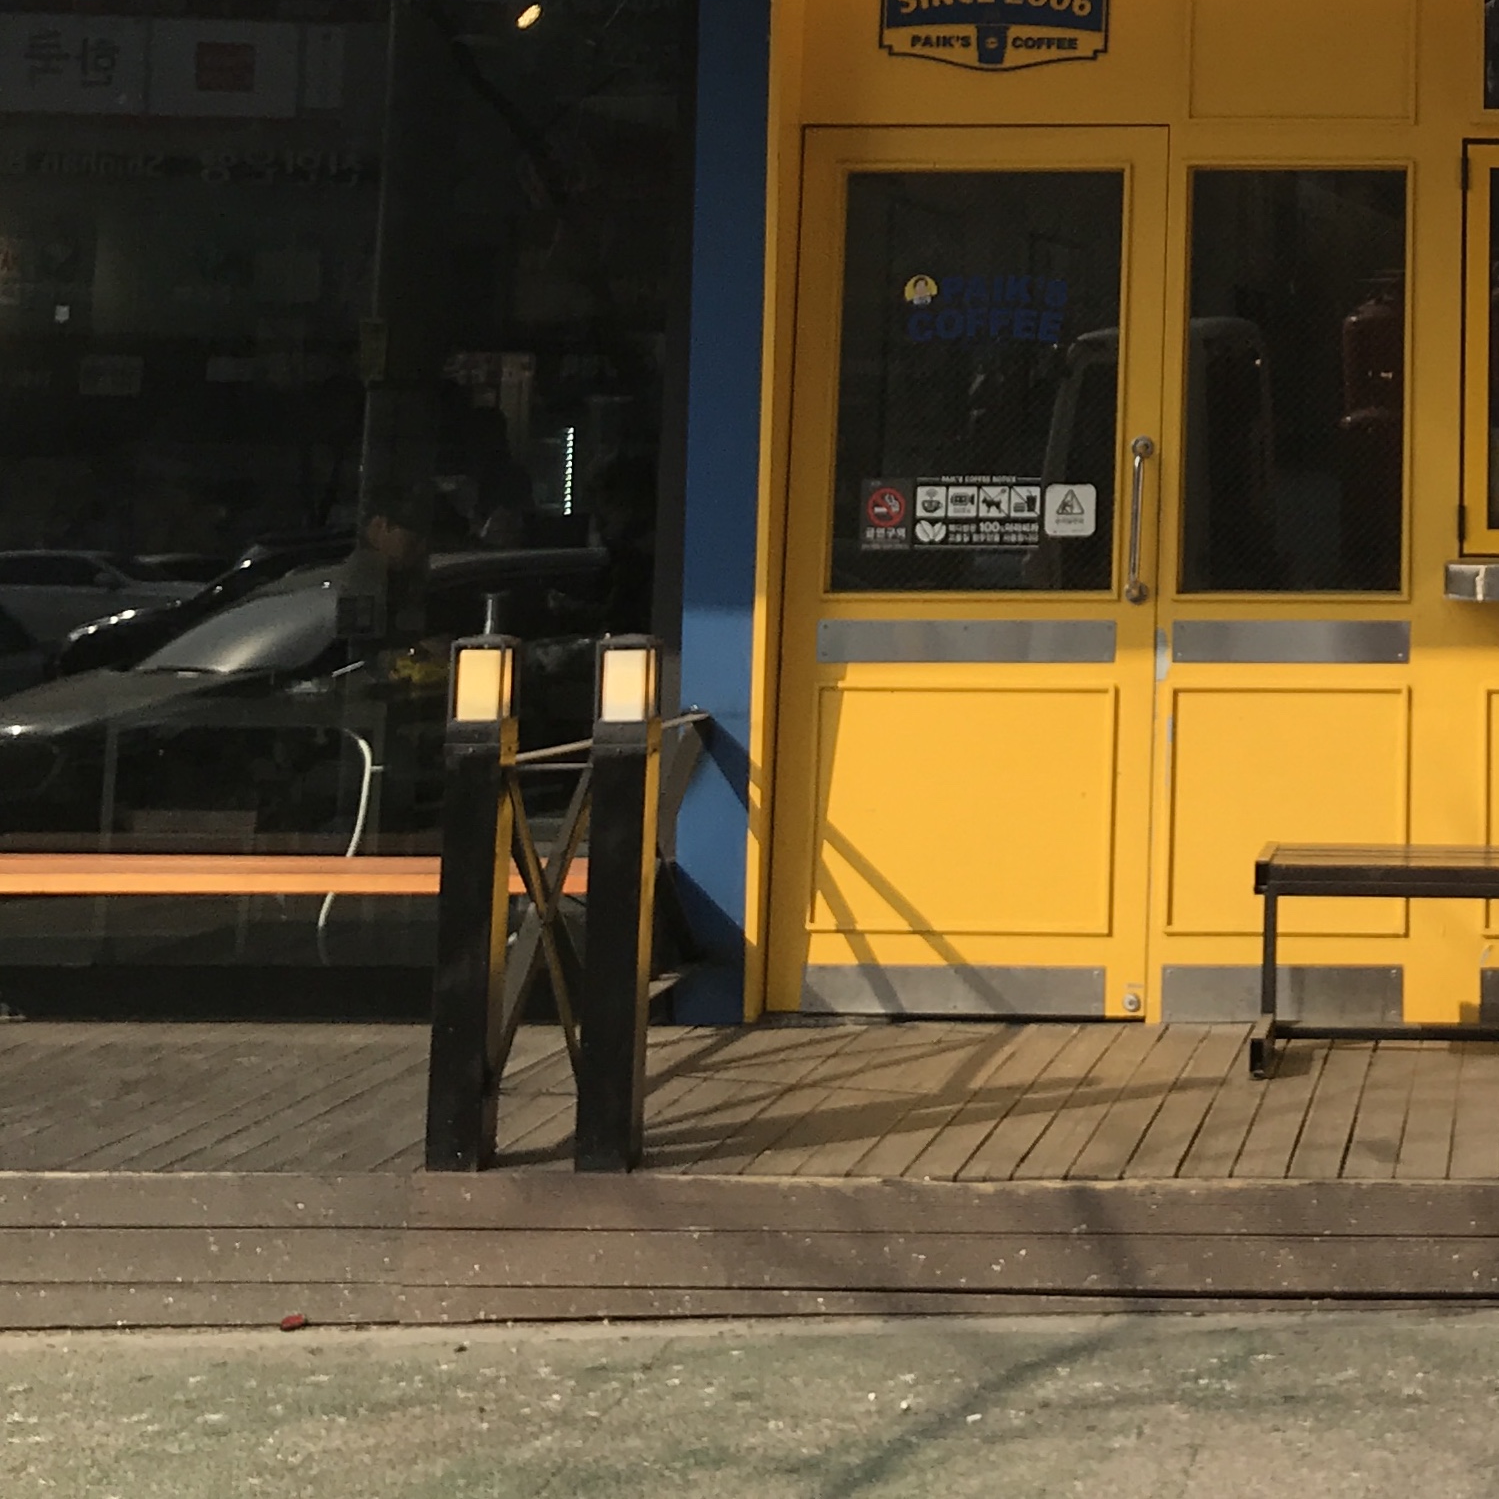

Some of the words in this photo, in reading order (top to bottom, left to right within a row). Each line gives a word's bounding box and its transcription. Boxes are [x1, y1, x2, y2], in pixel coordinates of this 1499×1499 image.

[910, 33, 973, 50] PAIK'S
[1010, 36, 1079, 51] COFFEE
[906, 308, 1065, 342] COFFEE
